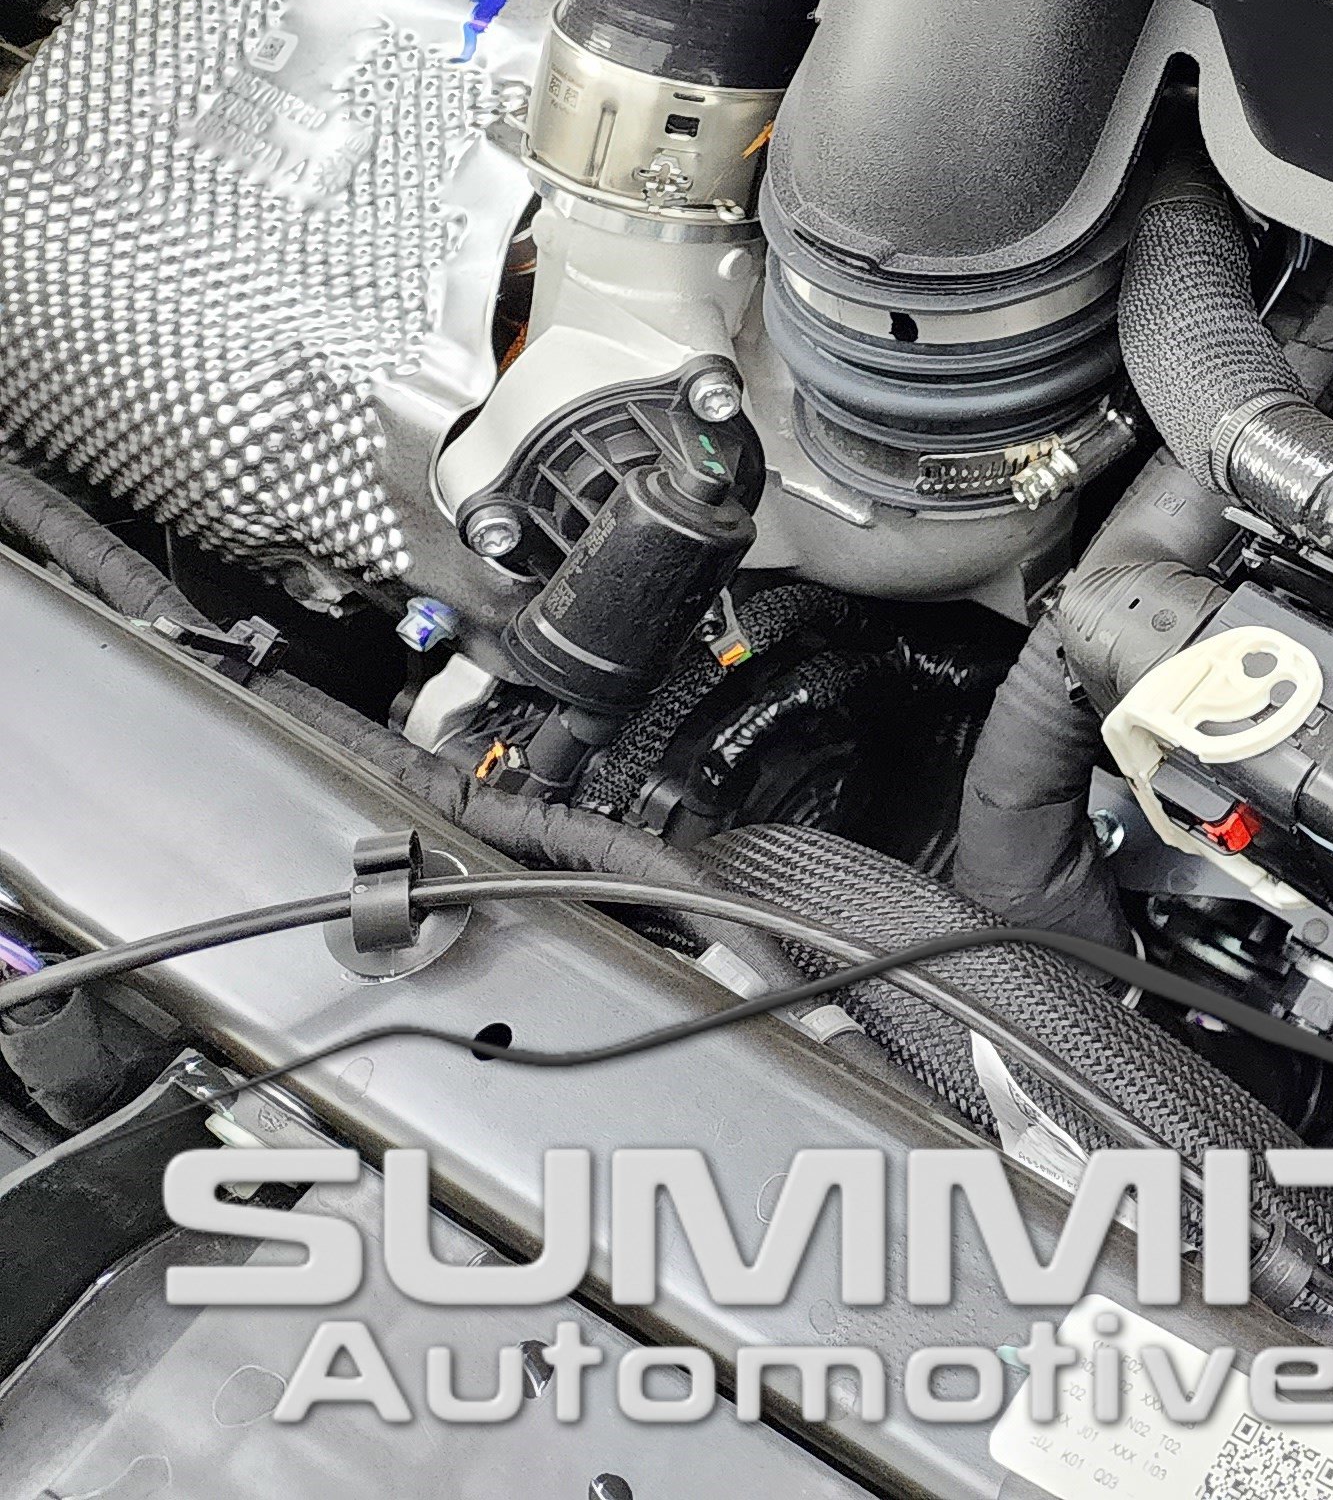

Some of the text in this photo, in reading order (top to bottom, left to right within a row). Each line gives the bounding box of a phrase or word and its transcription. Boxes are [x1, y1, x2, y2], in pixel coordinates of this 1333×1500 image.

[1127, 1416, 1151, 1437] N02
[1160, 1434, 1182, 1455] T02
[1093, 1468, 1120, 1489] Q03
